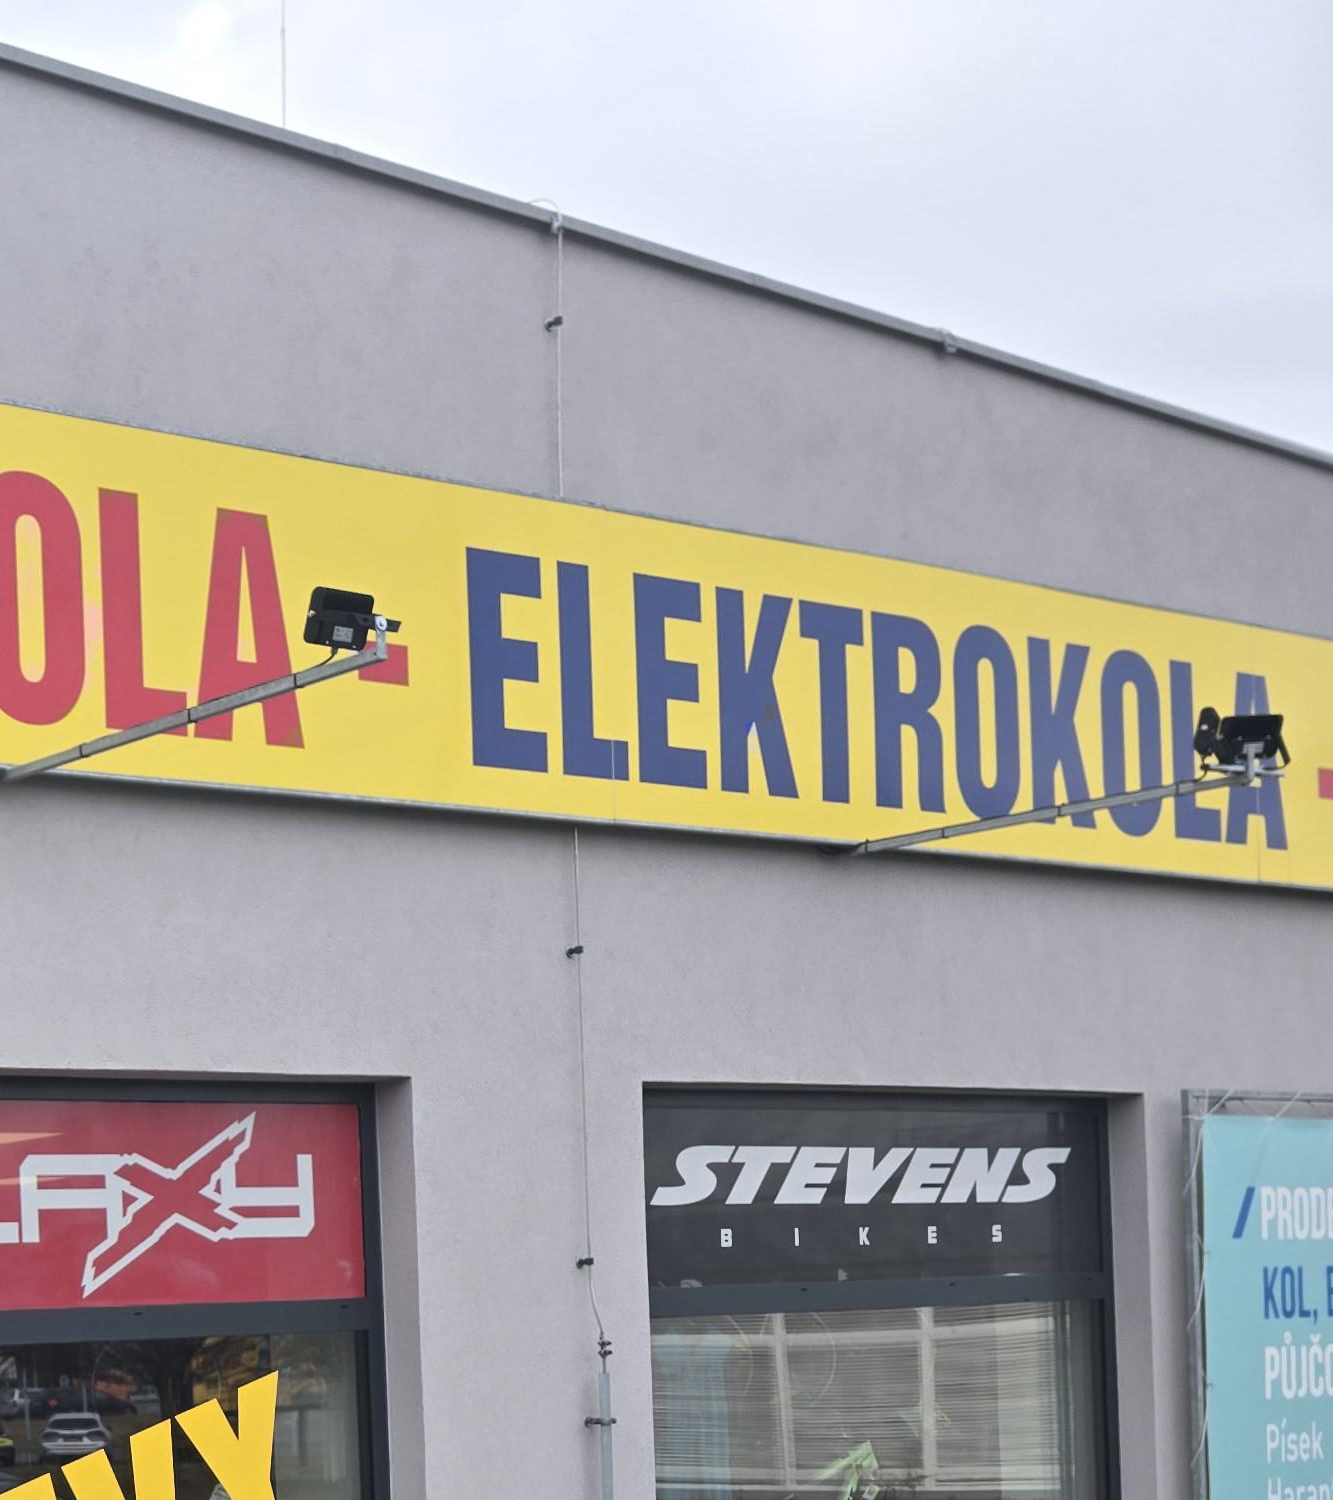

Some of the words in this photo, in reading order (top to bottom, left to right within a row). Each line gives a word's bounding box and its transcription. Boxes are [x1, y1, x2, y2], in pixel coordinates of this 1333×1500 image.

[464, 545, 1288, 851] ELEKTROKOLA
[649, 1143, 1071, 1207] STEVENS
[1262, 1265, 1318, 1325] KOL,
[1266, 1418, 1324, 1465] Písek
